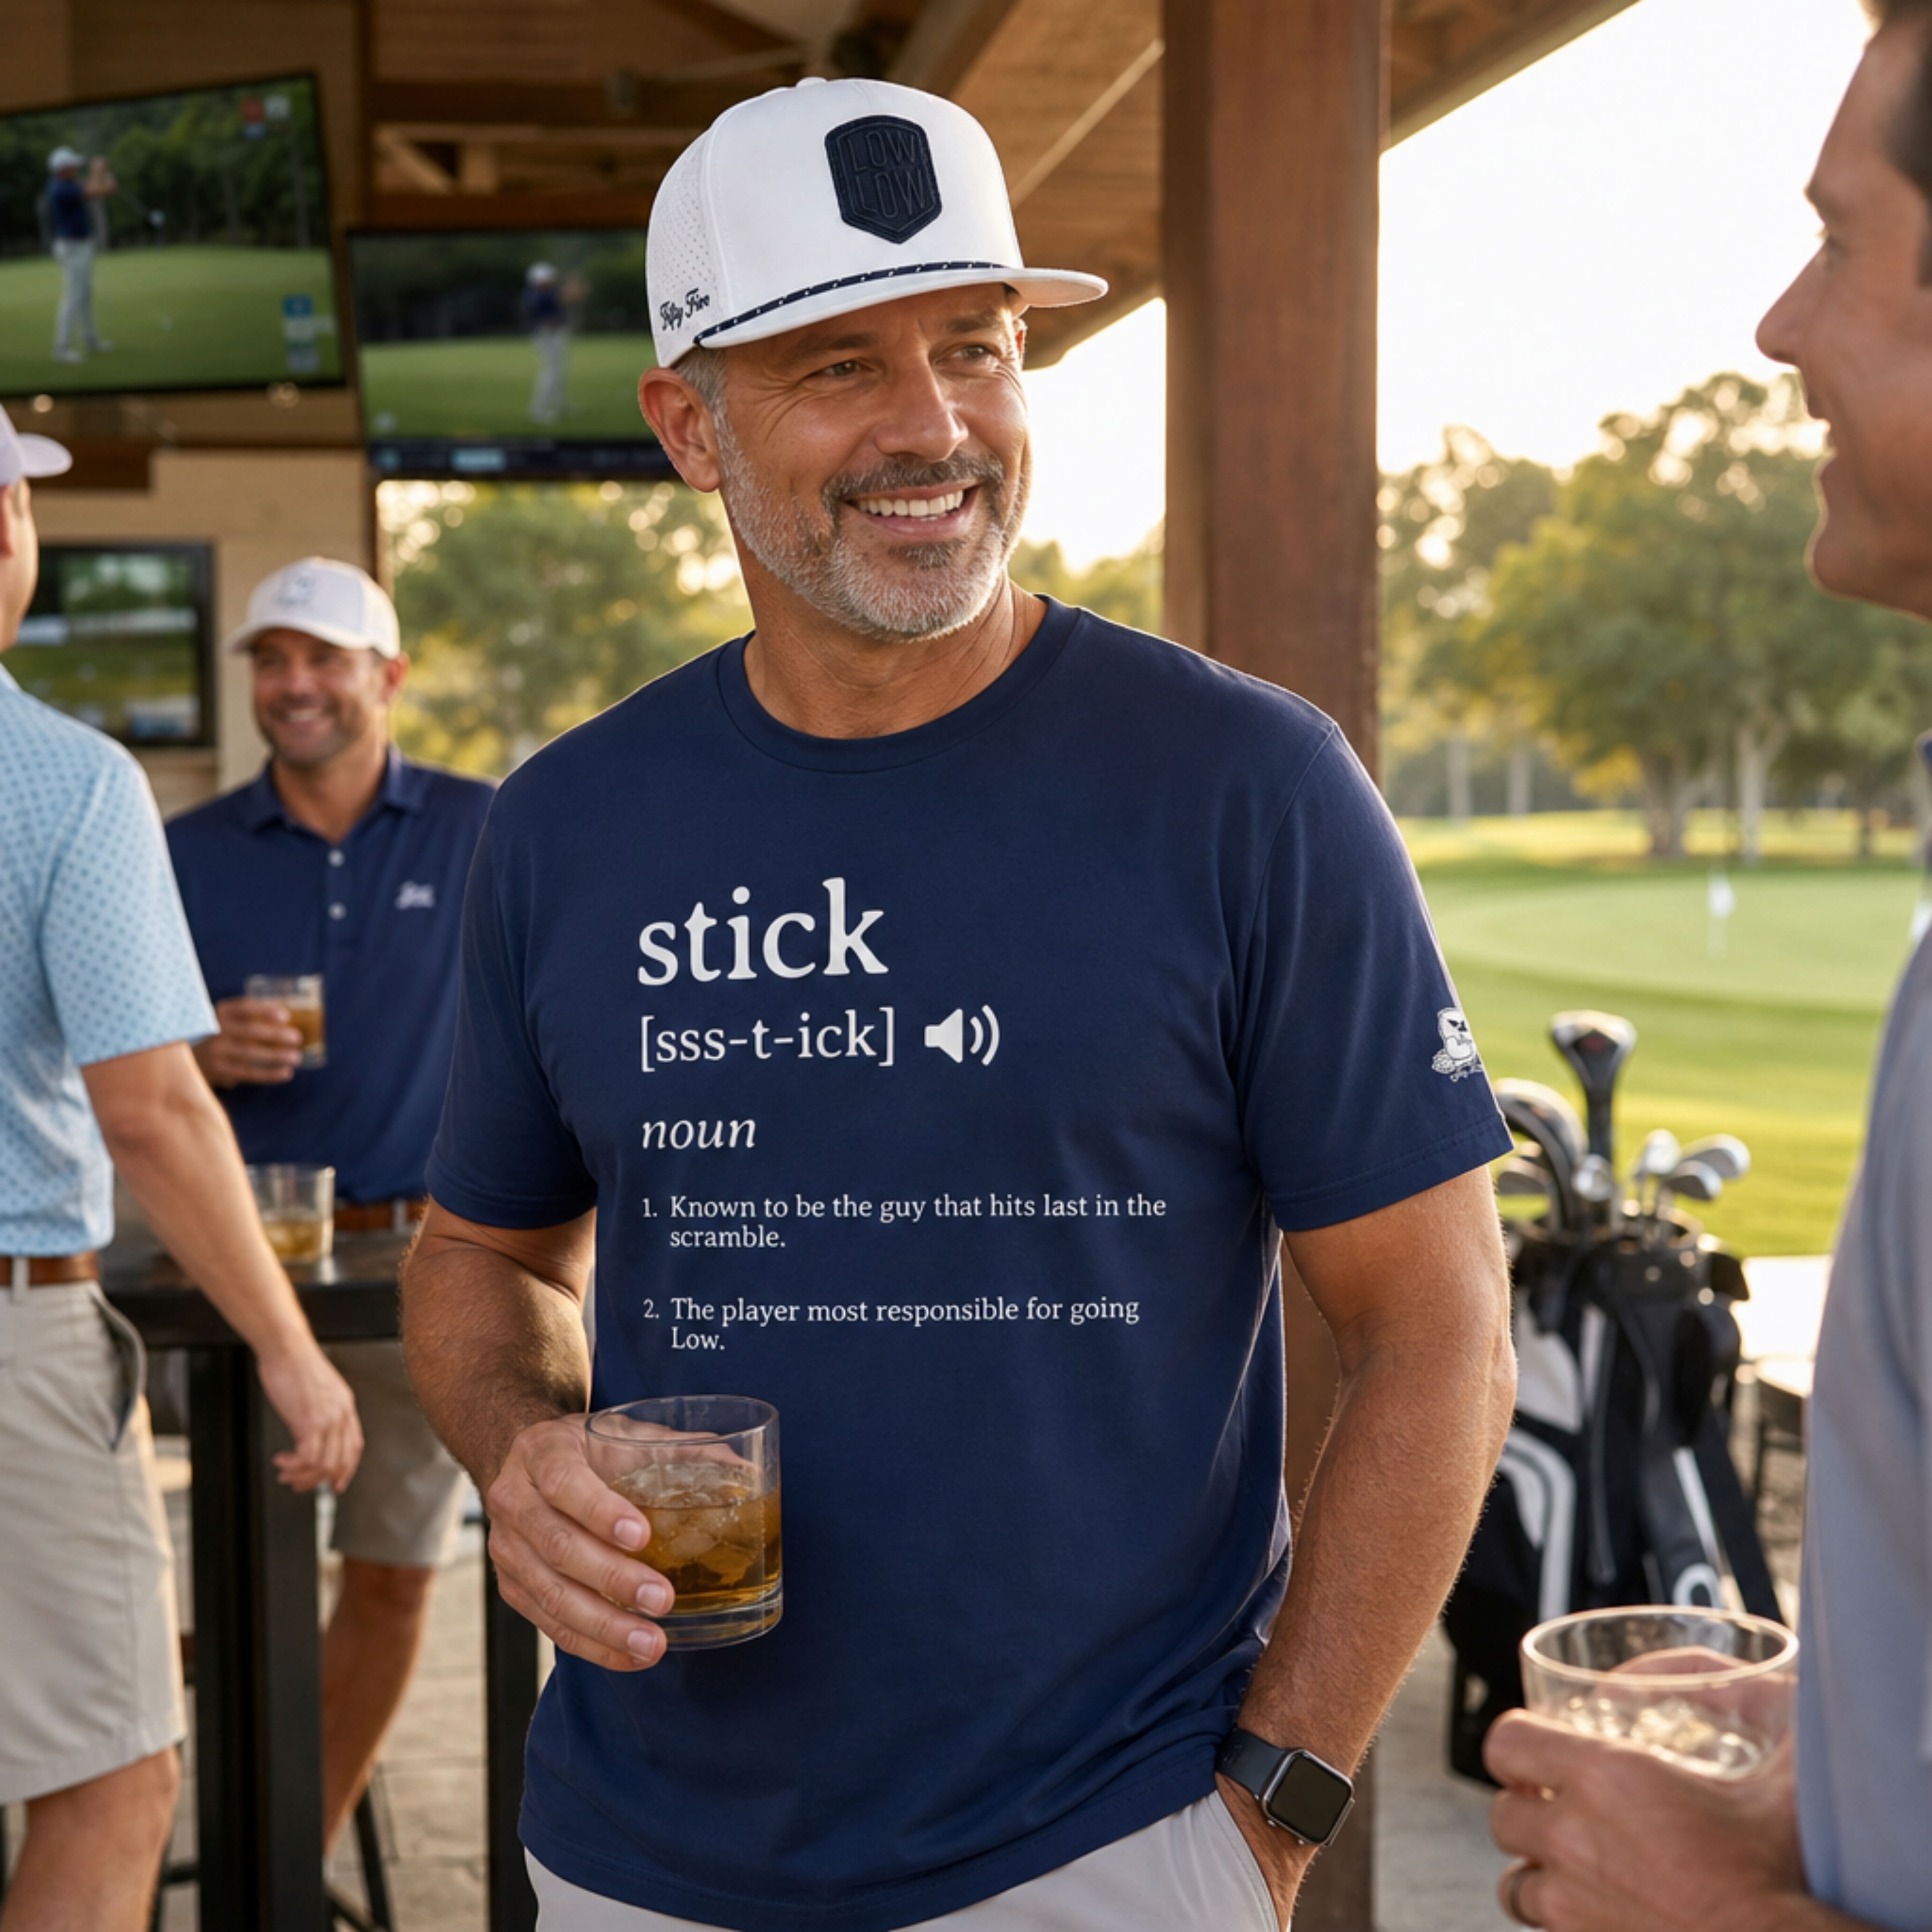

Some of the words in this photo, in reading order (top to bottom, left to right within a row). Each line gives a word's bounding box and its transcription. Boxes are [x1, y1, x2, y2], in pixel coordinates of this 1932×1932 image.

[846, 128, 916, 171] LOW
[856, 170, 925, 218] LOW
[637, 876, 889, 986] stick
[641, 1006, 894, 1073] [sss-t-ick]
[642, 1118, 756, 1150] noun
[643, 1198, 657, 1217] 1.
[671, 1196, 756, 1217] Known
[764, 1198, 788, 1218] to
[796, 1194, 825, 1217] be
[833, 1194, 872, 1217] the
[880, 1201, 926, 1223] guy
[934, 1194, 982, 1216] that
[990, 1193, 1035, 1216] hits
[1044, 1194, 1088, 1216] last
[1096, 1194, 1119, 1216] in
[1128, 1194, 1166, 1216] the
[670, 1224, 785, 1248] scramble.
[643, 1299, 659, 1318] 2.
[671, 1298, 714, 1320] The
[722, 1298, 800, 1327] player
[808, 1302, 868, 1321] most
[876, 1297, 1019, 1327] responsible
[1027, 1297, 1063, 1319] for
[1071, 1297, 1140, 1325] going
[672, 1327, 725, 1350] Low.
